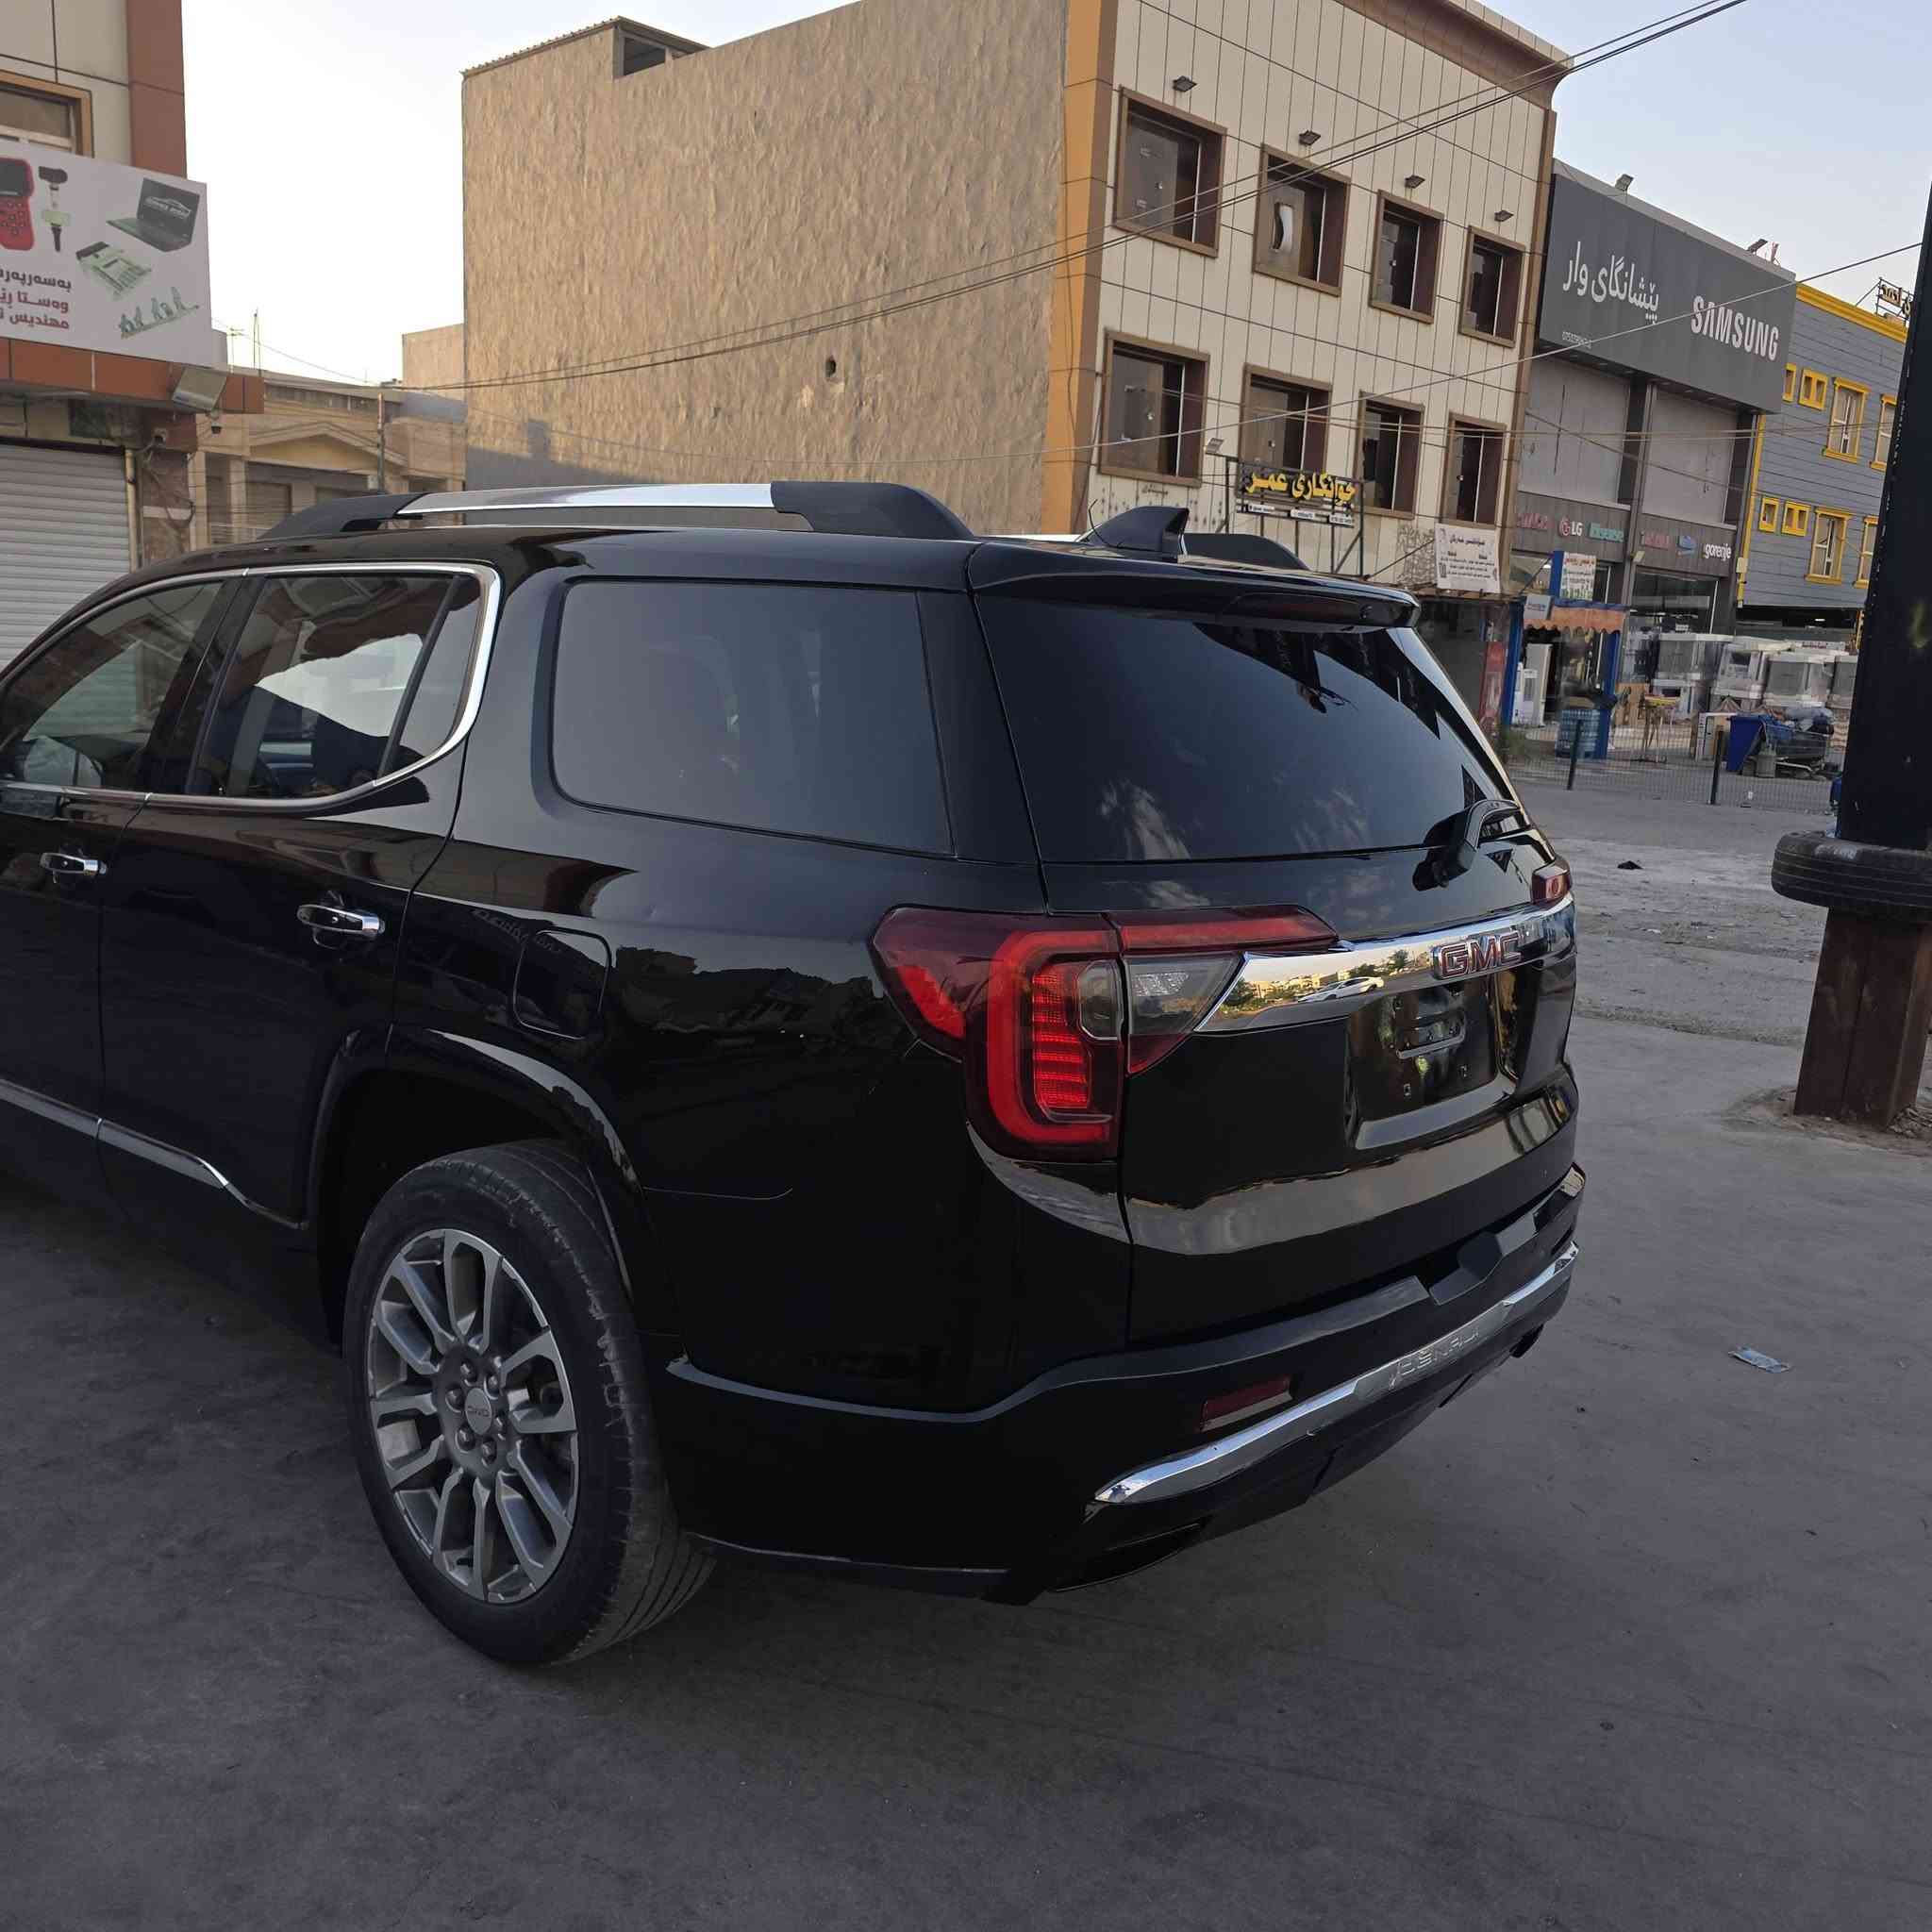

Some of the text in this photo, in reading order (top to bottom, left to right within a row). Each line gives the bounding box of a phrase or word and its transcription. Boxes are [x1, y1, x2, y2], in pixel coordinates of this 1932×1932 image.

[1690, 295, 1779, 360] SAMSUNG
[1572, 521, 1584, 537] LG
[1705, 543, 1732, 561] gorenje
[1434, 930, 1522, 978] GMC
